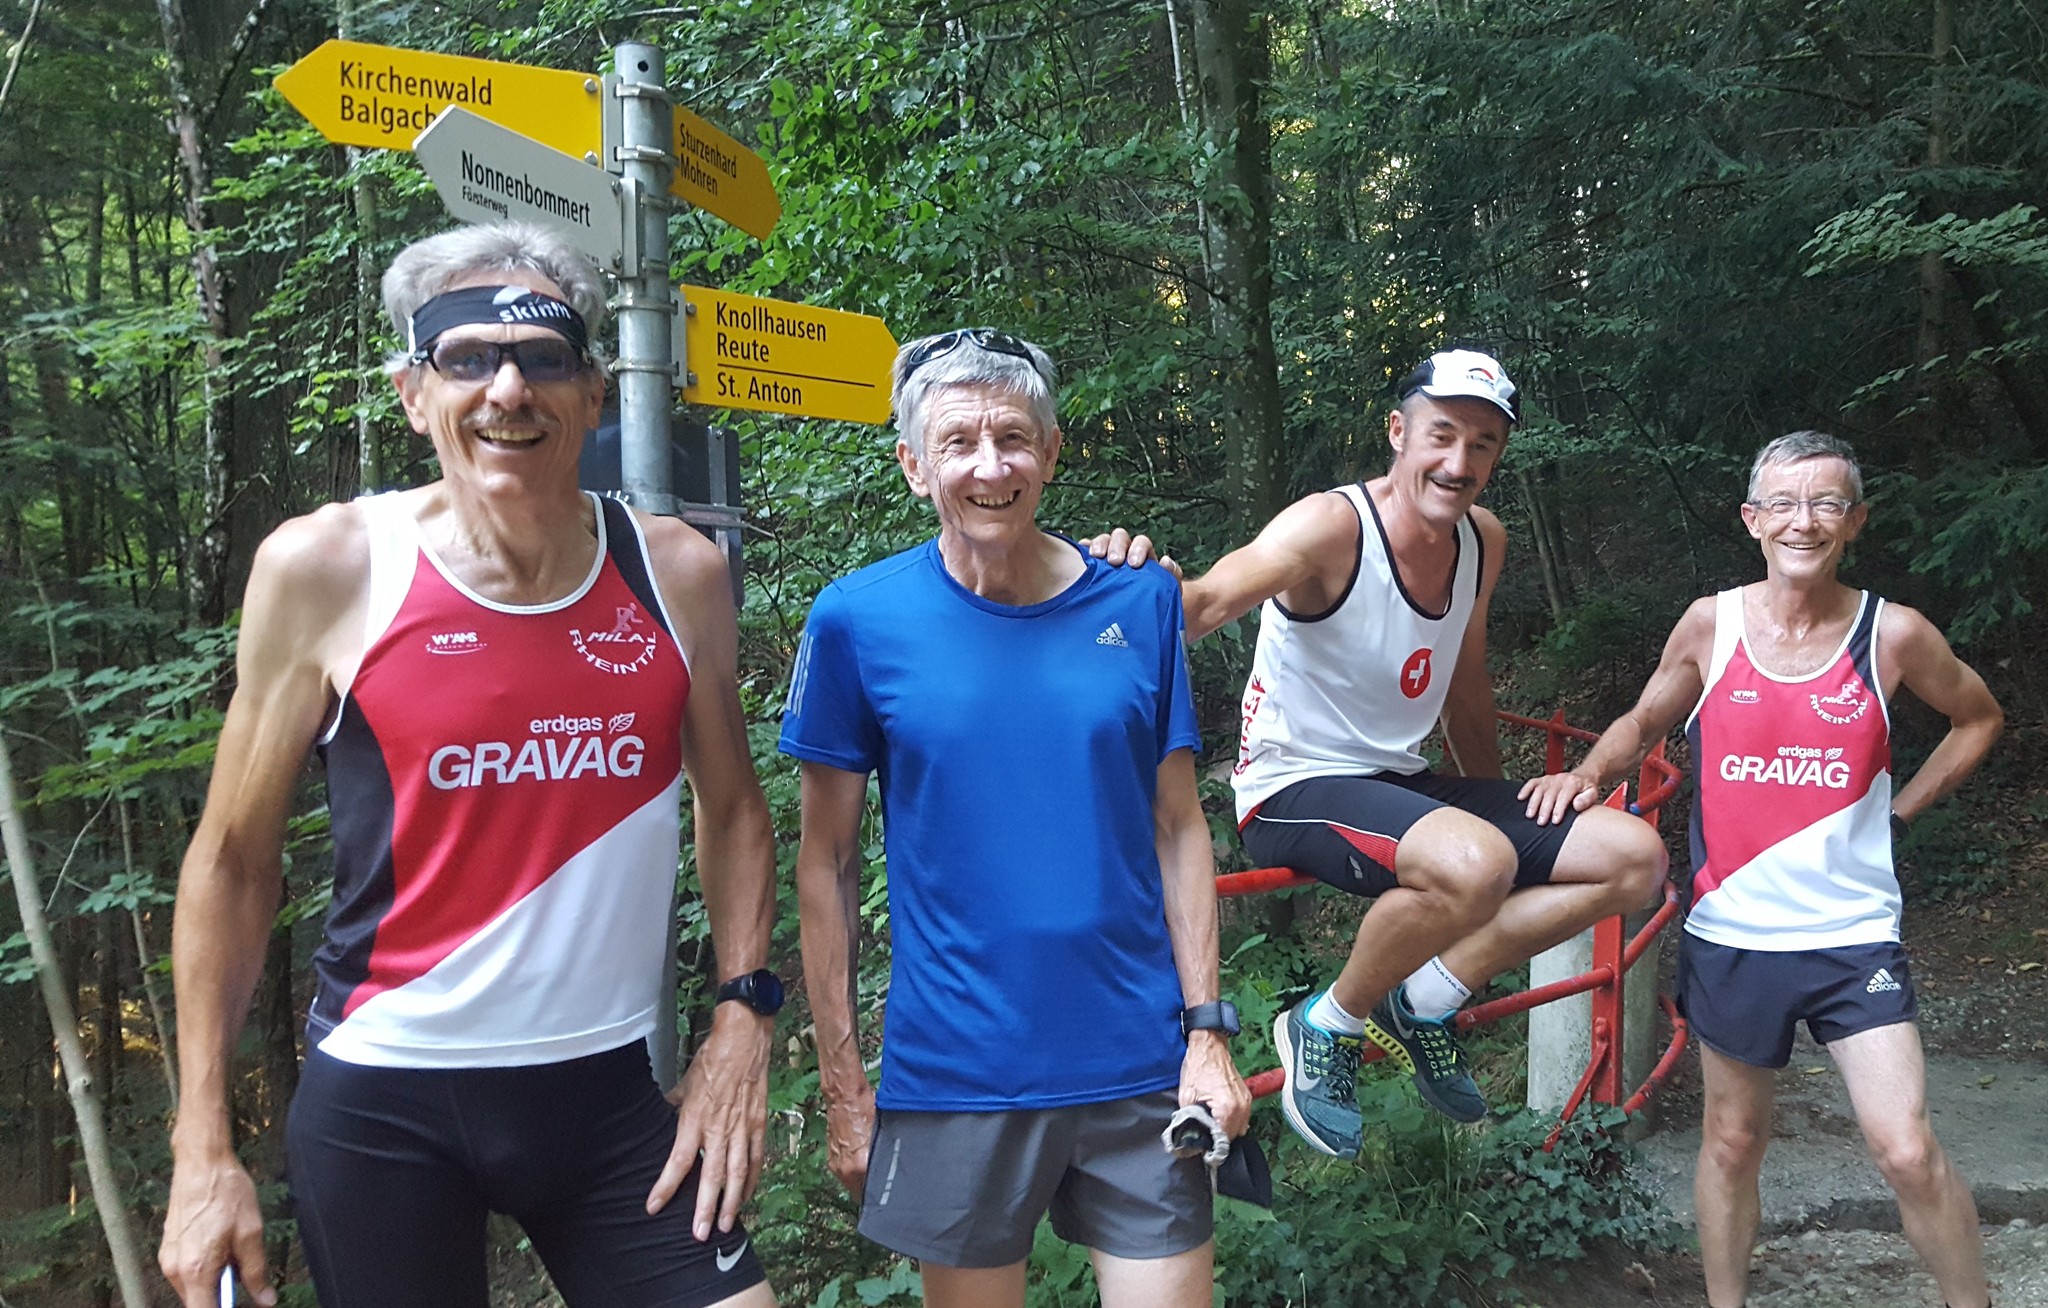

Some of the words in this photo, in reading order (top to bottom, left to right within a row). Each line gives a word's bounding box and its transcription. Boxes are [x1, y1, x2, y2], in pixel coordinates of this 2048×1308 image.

[340, 60, 493, 106] Kirchenwald
[340, 96, 437, 133] Balgach
[679, 122, 738, 179] Sturzenhard
[461, 150, 592, 228] Nonnenbommert
[679, 153, 719, 197] Mohren
[716, 301, 827, 342] Knollhausen
[716, 332, 770, 363] Reute
[717, 371, 741, 399] St.
[748, 376, 802, 406] Anton
[568, 629, 657, 675] RHEINTAL
[586, 631, 645, 644] MILA
[1095, 636, 1130, 649] adidas
[529, 714, 604, 736] erdgas
[1809, 694, 1868, 725] RHEINTAL
[428, 736, 645, 790] GRAVAG
[1777, 744, 1823, 760] erdgas
[1719, 753, 1850, 790] GRAVAG
[1866, 981, 1902, 994] adidas
